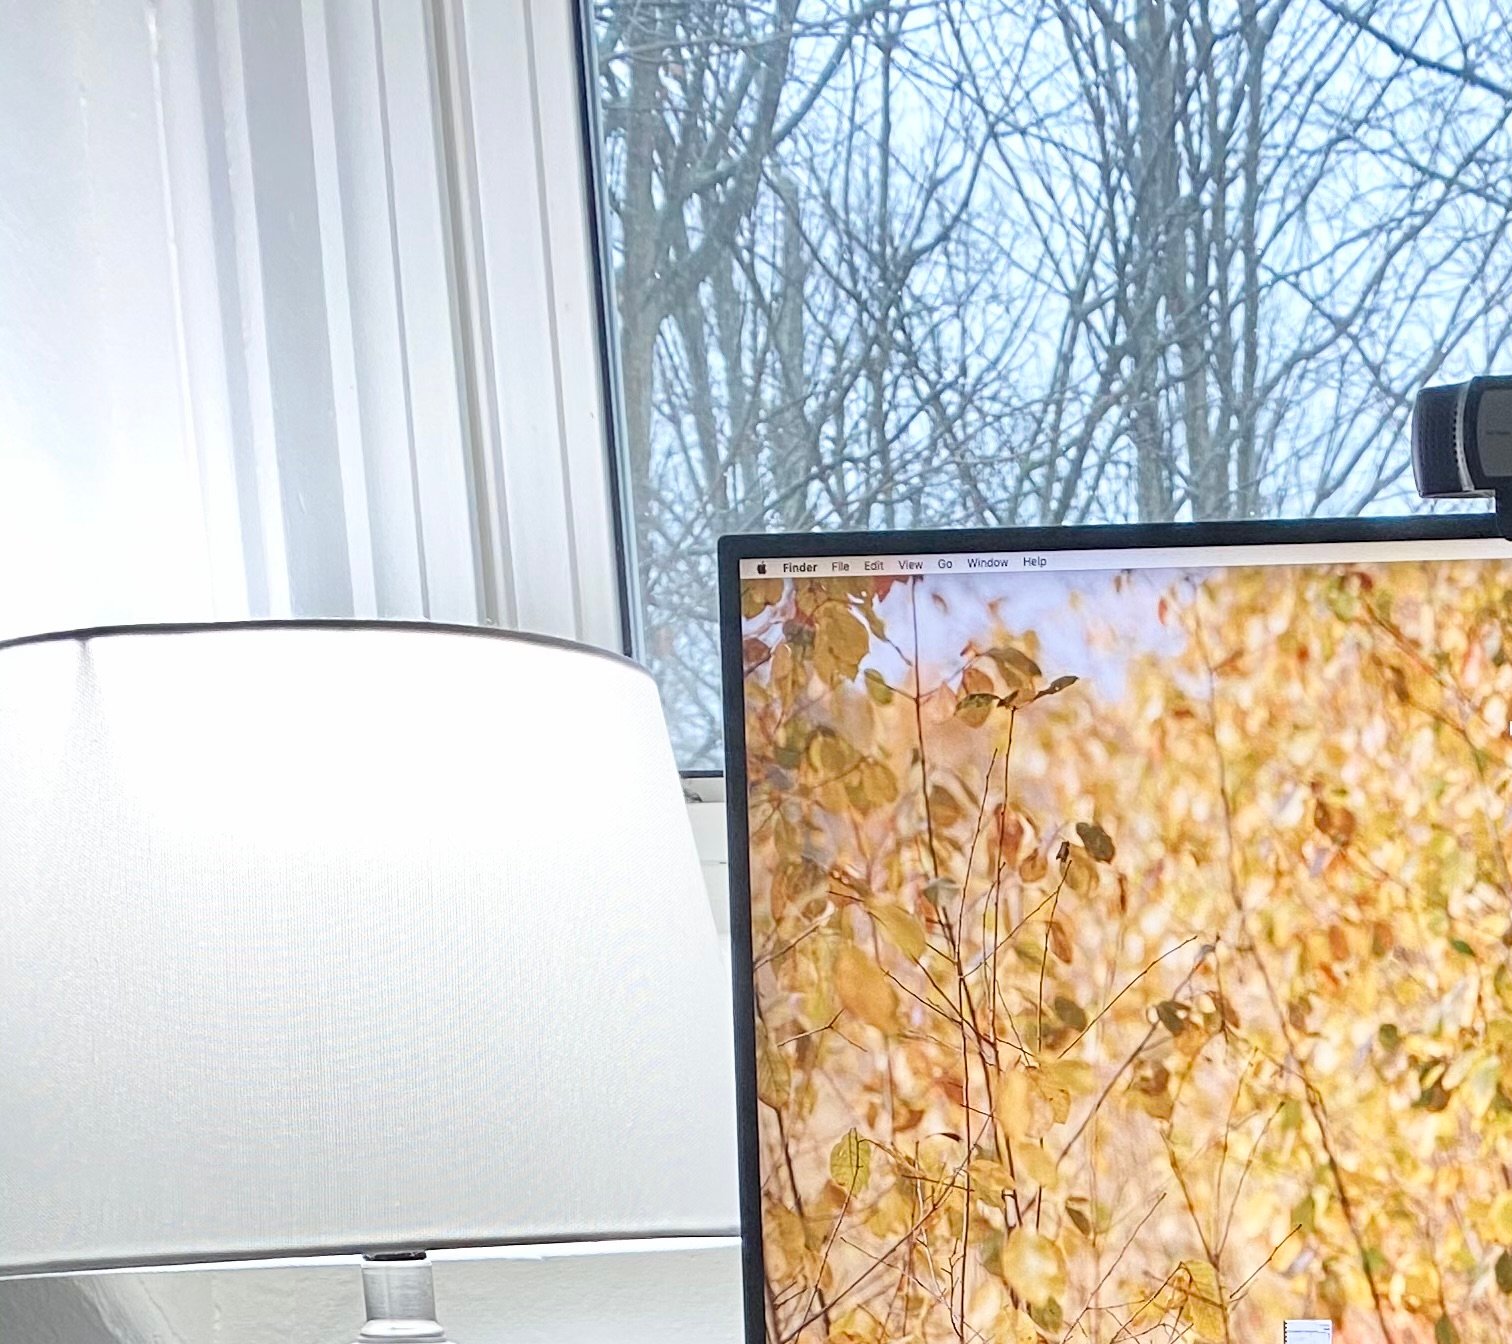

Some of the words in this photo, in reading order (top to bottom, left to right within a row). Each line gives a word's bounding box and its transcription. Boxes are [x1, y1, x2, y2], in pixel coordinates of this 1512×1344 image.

[783, 563, 818, 573] Finder
[832, 562, 850, 571] File
[864, 561, 884, 571] Edit
[898, 559, 924, 570] View
[938, 559, 953, 569] Go
[967, 557, 1009, 568] Window
[1023, 556, 1048, 568] Help
